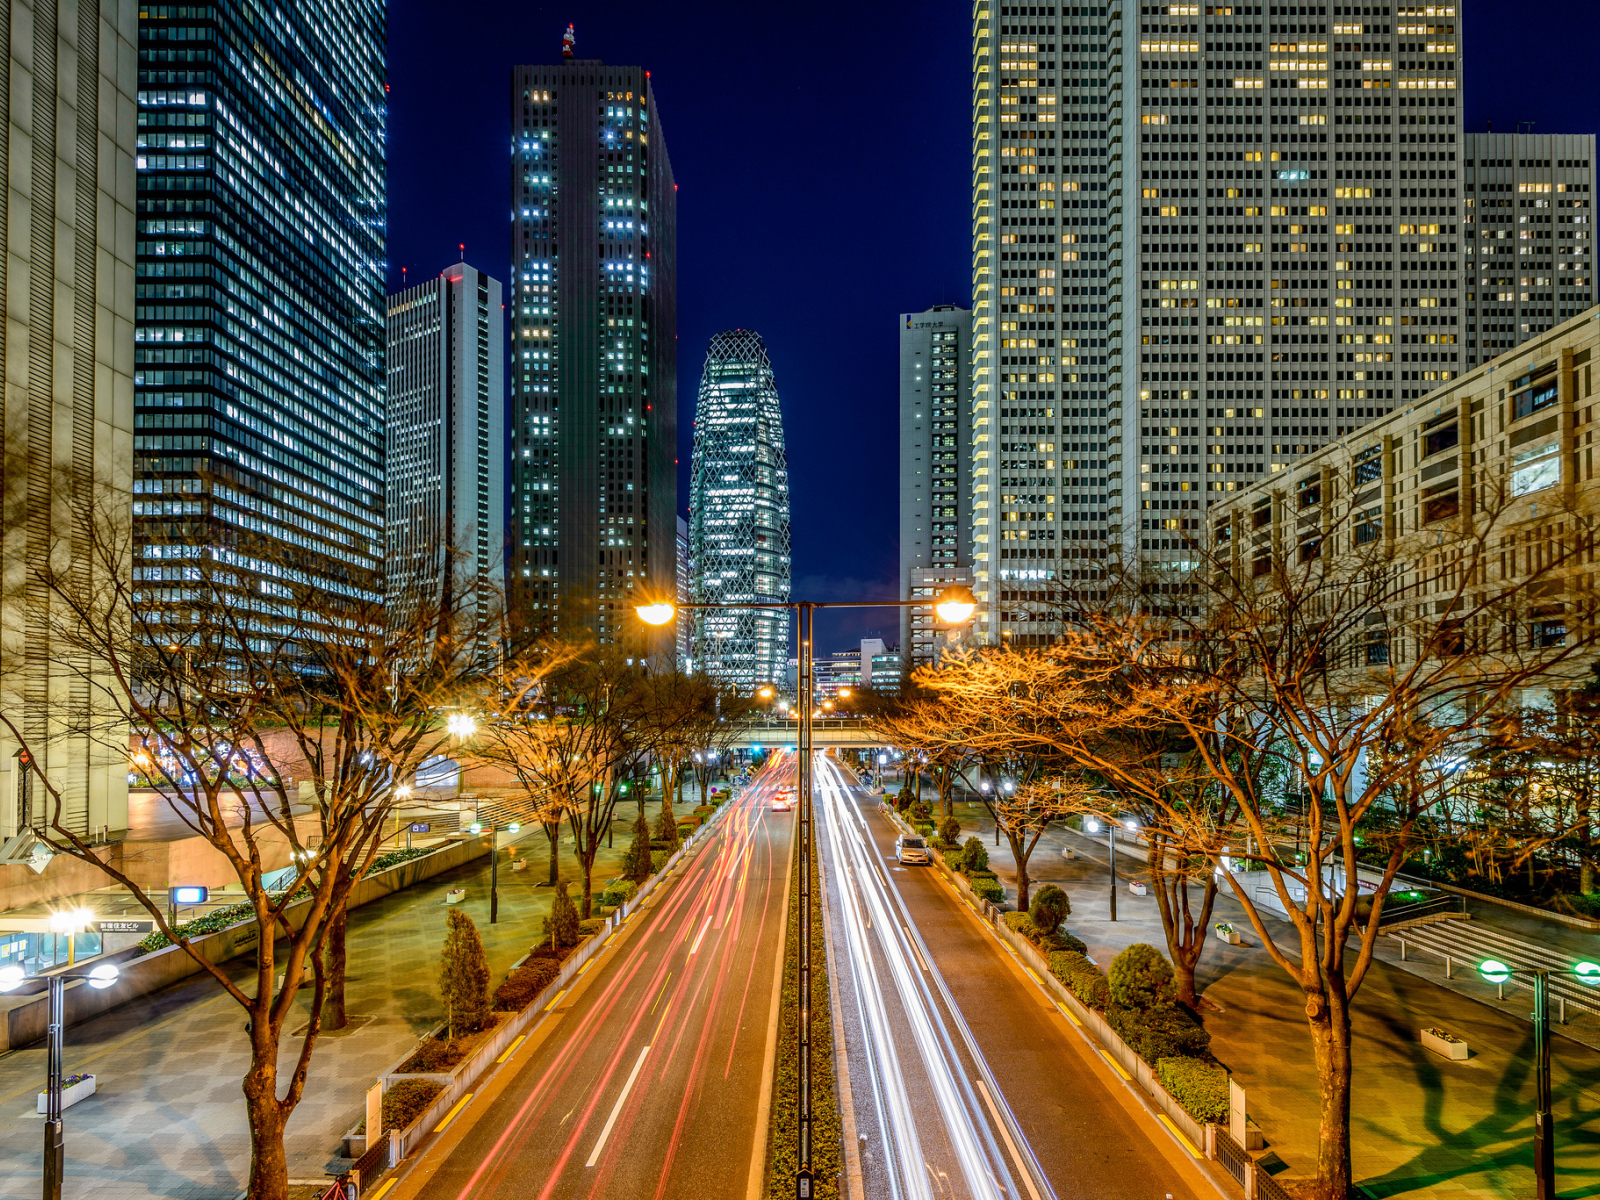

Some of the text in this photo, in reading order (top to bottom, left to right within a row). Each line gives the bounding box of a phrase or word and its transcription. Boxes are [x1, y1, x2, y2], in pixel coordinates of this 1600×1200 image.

[914, 321, 943, 329] 工学院大学
